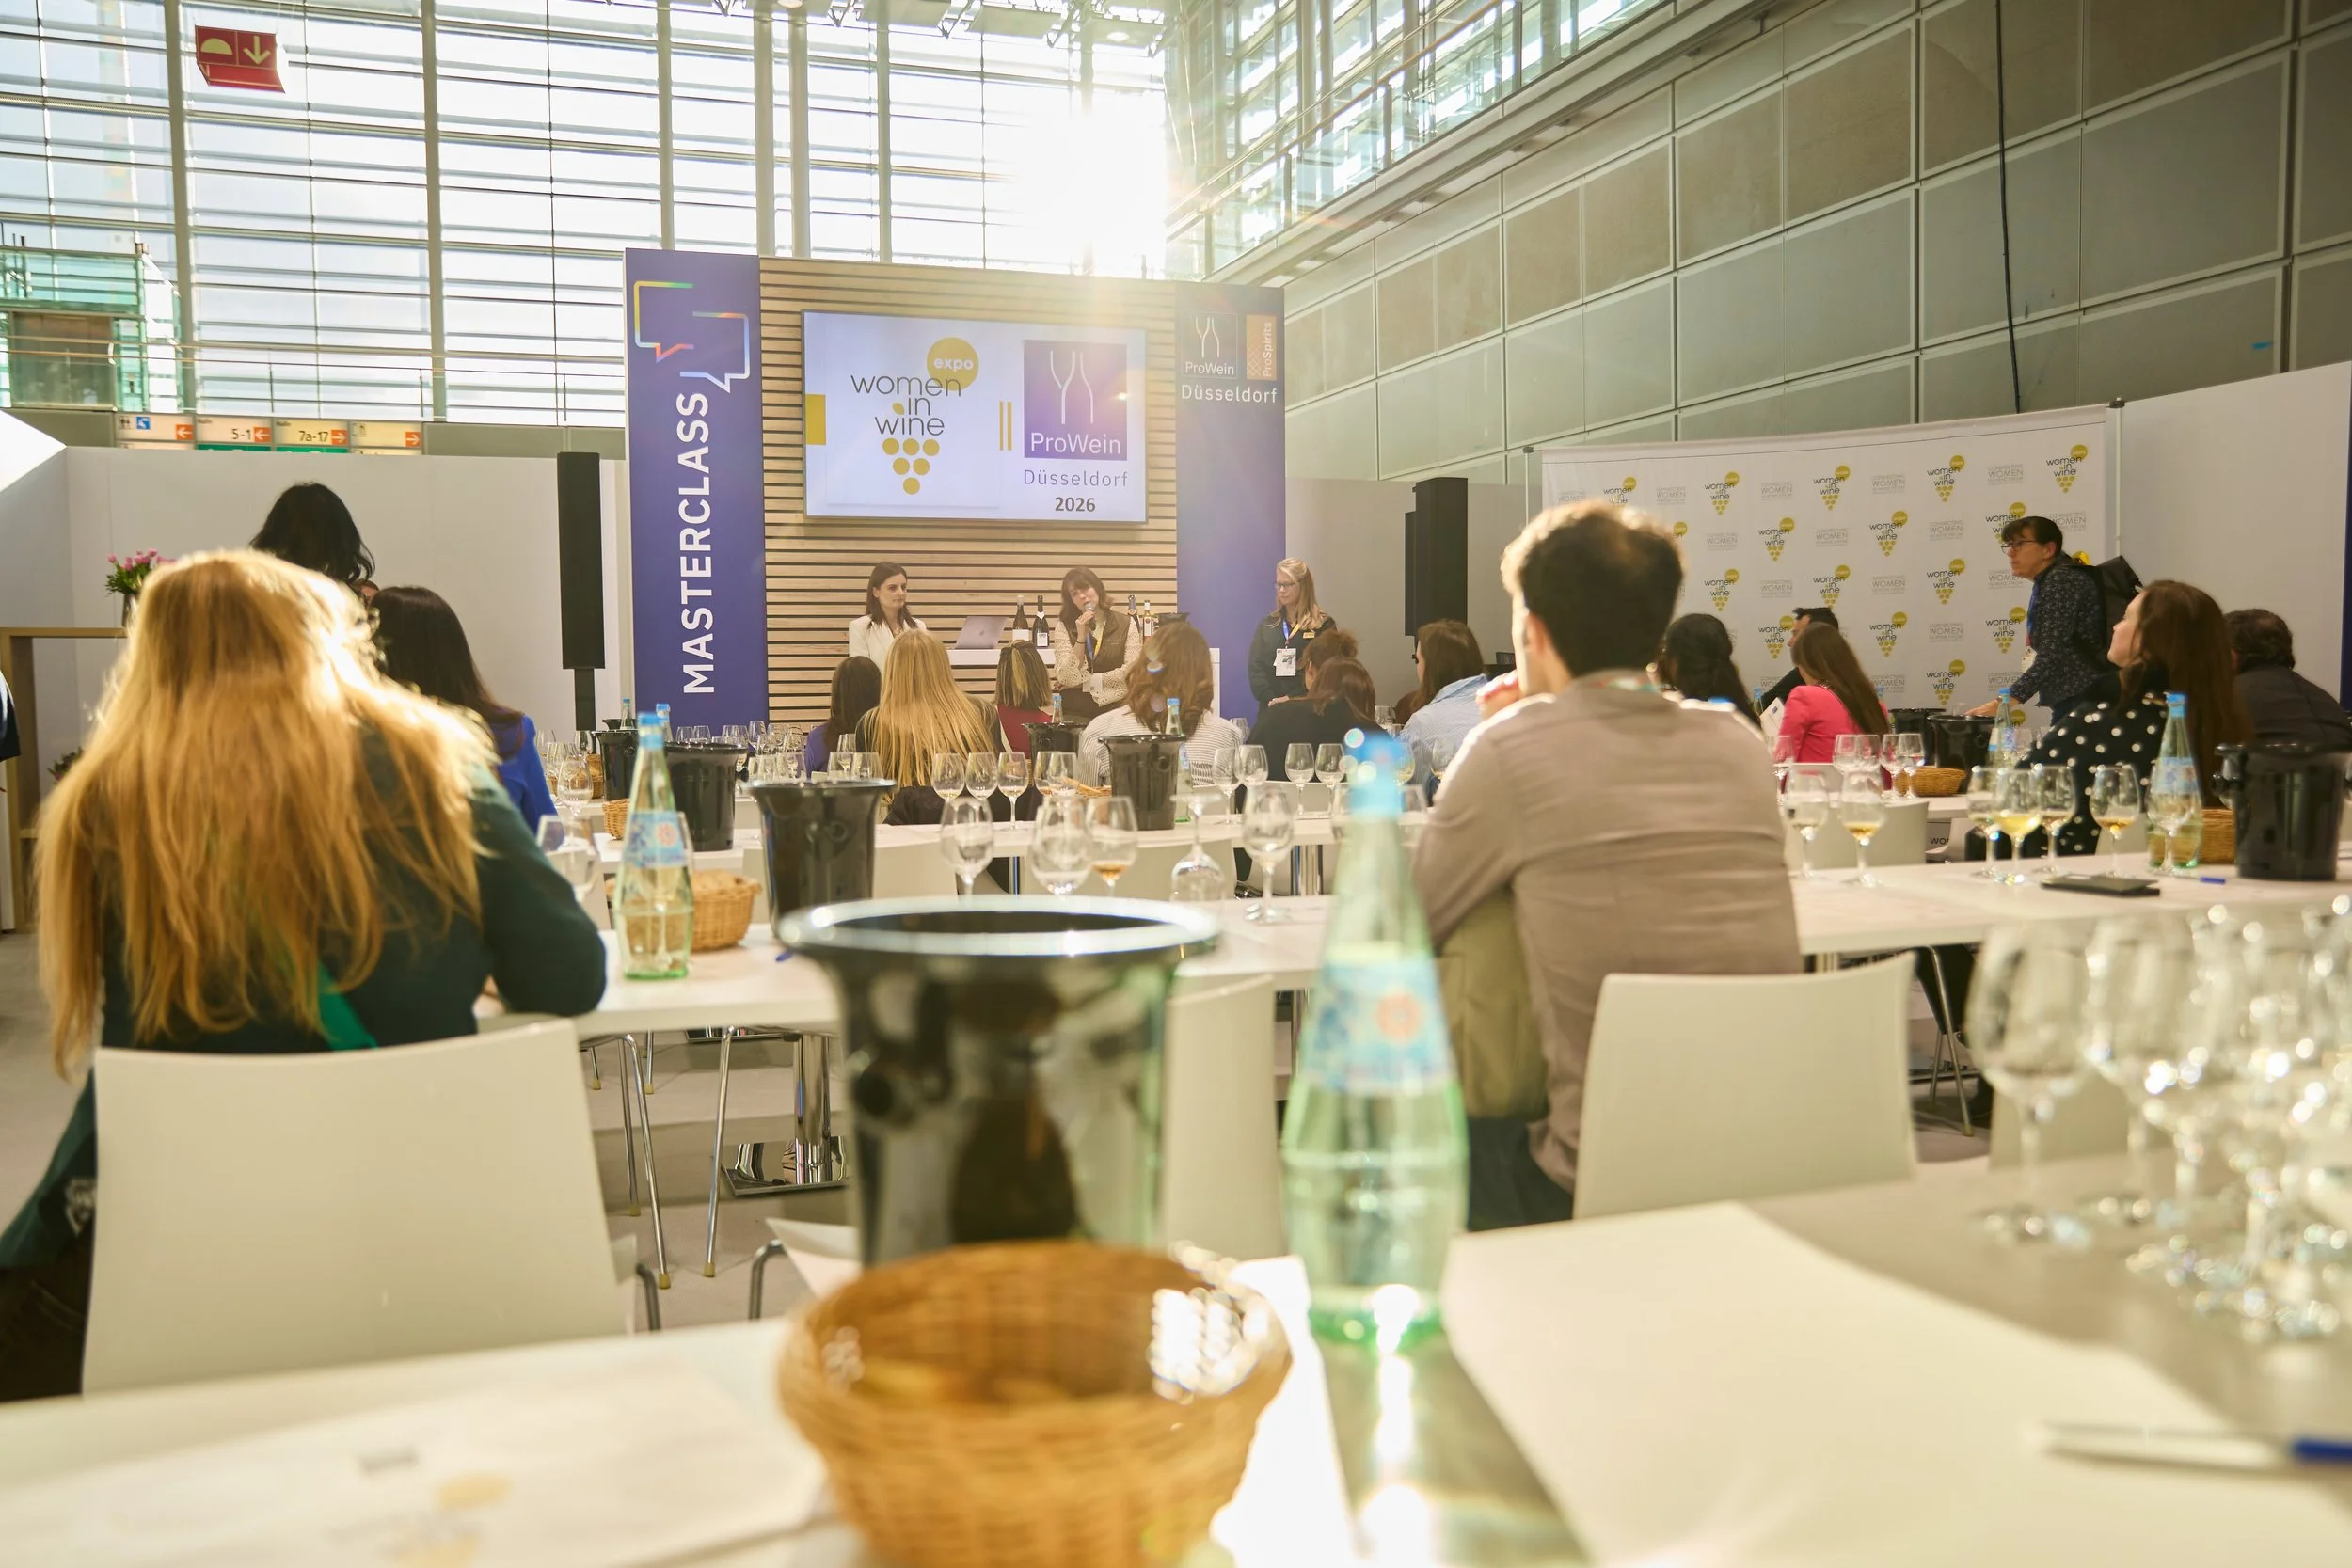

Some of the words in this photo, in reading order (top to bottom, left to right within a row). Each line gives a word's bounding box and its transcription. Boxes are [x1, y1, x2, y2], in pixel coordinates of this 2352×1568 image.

[1263, 322, 1273, 377] ProSpirits
[933, 358, 974, 372] expo
[1185, 361, 1234, 375] ProWein
[850, 375, 961, 397] women
[1182, 384, 1278, 404] Düsseldorf
[908, 397, 930, 416] in
[875, 417, 945, 436] wine
[298, 430, 328, 442] 7a-17
[1030, 432, 1120, 454] ProWein
[2046, 457, 2082, 466] women
[1024, 469, 1128, 487] Düsseldorf
[1927, 467, 1961, 476] women
[1988, 469, 2023, 478] WOMEN
[1657, 490, 1686, 499] WOMEN
[1055, 497, 1096, 513] 2026
[1930, 525, 1963, 533] WOMEN
[675, 392, 715, 693] MASTERCLASS
[1707, 536, 1738, 545] WOMEN
